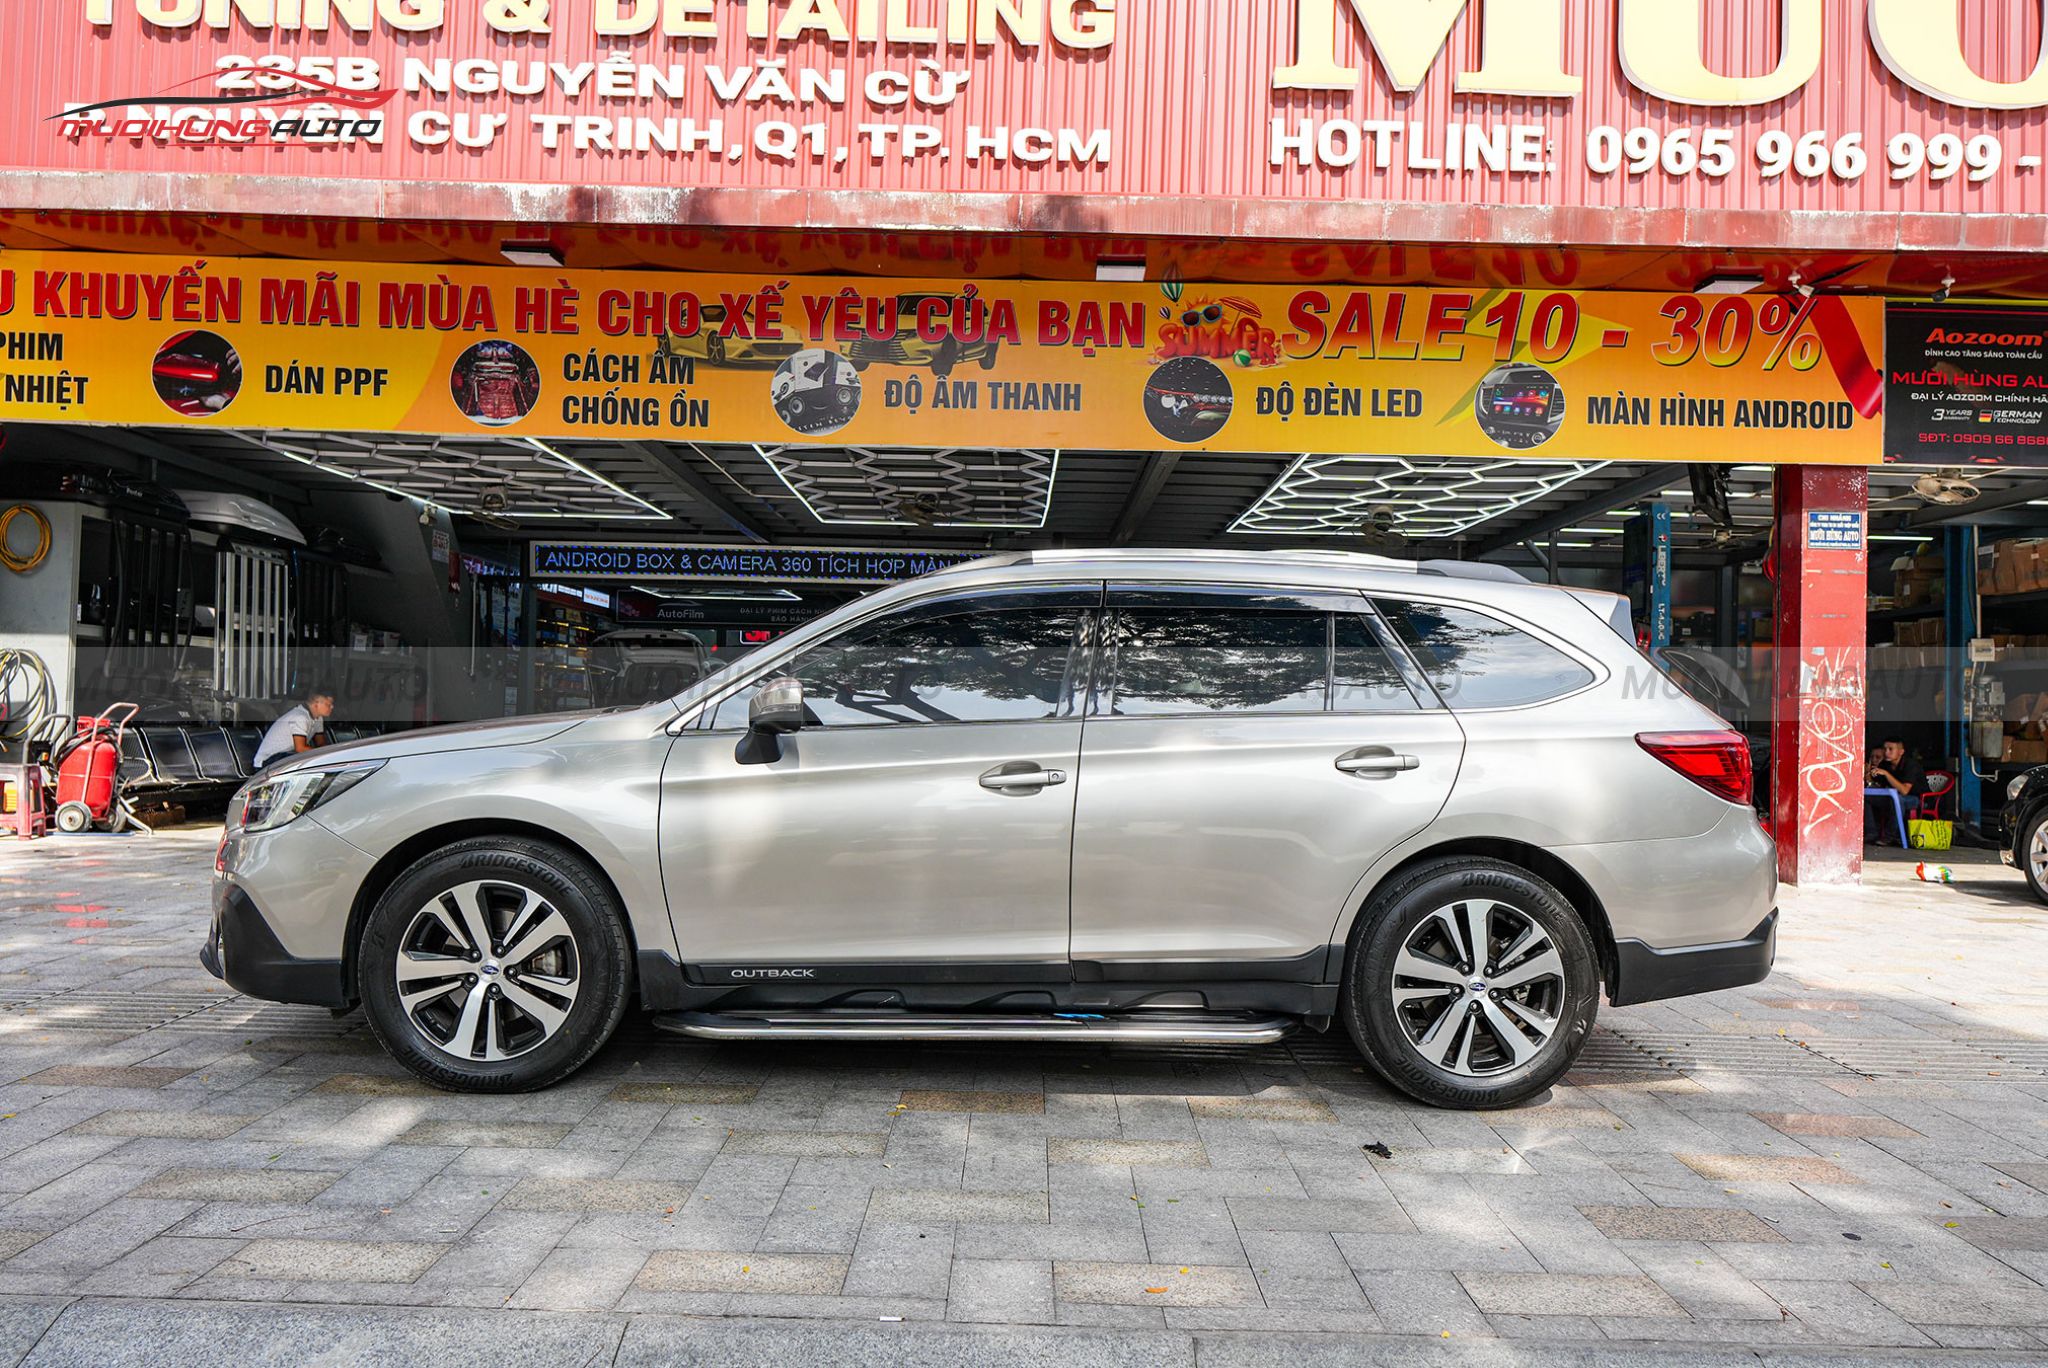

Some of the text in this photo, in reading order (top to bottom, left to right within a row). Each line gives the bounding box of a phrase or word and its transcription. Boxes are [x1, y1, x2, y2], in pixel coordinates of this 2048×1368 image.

[482, 0, 552, 34] &
[594, 0, 1115, 49] DETAILING
[214, 51, 972, 106] 235B NGUYỄN VĂN CỪ
[407, 110, 508, 147] CƯ
[530, 114, 743, 160] TRINH,
[754, 120, 849, 163] Q1,
[858, 123, 950, 158] TP.
[965, 125, 1112, 163] HCM
[1269, 117, 1556, 173] HOTLINE:
[1585, 125, 1735, 177] 0965
[1755, 129, 1867, 180] 966
[1886, 131, 2002, 182] 999
[33, 259, 243, 323] KHUYẾN
[259, 270, 361, 328] MÃI
[377, 273, 498, 332] MÙA
[514, 278, 580, 335] HÈ
[597, 288, 702, 338] CHO
[717, 280, 791, 340] XẾ
[801, 286, 898, 344] YÊU
[916, 283, 1020, 347] CỦA
[1037, 299, 1147, 357] BẠN
[1154, 317, 1277, 364] SUMMER
[1280, 289, 1474, 361] SALE
[1484, 290, 1580, 364] 10
[1650, 294, 1823, 371] 30%
[1925, 327, 2043, 346] Aozoom
[562, 347, 695, 386] CÁCH ÂM
[1944, 350, 1961, 358] CAO
[1983, 349, 2005, 359] SÁNG
[4, 369, 89, 411] NHIỆT
[264, 359, 389, 397] DÁN PPF
[883, 374, 1082, 415] ĐỘ ÂM THANH
[1910, 392, 1929, 403] ĐẠI
[1931, 390, 1945, 401] LÝ
[1945, 393, 1993, 402] AOZOOM
[1994, 392, 2031, 404] CHÍNH
[1953, 369, 2018, 388] HÙNG
[561, 387, 710, 428] CHỐNG ỒN
[1255, 380, 1423, 422] ĐỘ ĐÈN LED
[1587, 389, 1854, 430] MÀN HÌNH ANDROID
[1930, 408, 1946, 421] 3
[1993, 409, 2043, 419] GERMAN
[1953, 433, 1992, 444] 0909
[1994, 434, 2014, 445] 66
[2017, 435, 2048, 446] 868
[545, 551, 631, 569] ANDROID
[636, 552, 675, 570] BOX
[681, 553, 693, 570] &
[698, 554, 777, 572] CAMERA
[781, 555, 812, 573] 360
[816, 551, 859, 575] TÍCH
[865, 556, 906, 578] HỢP
[657, 607, 705, 620] AutoFilm
[730, 968, 815, 979] OUTBACK
